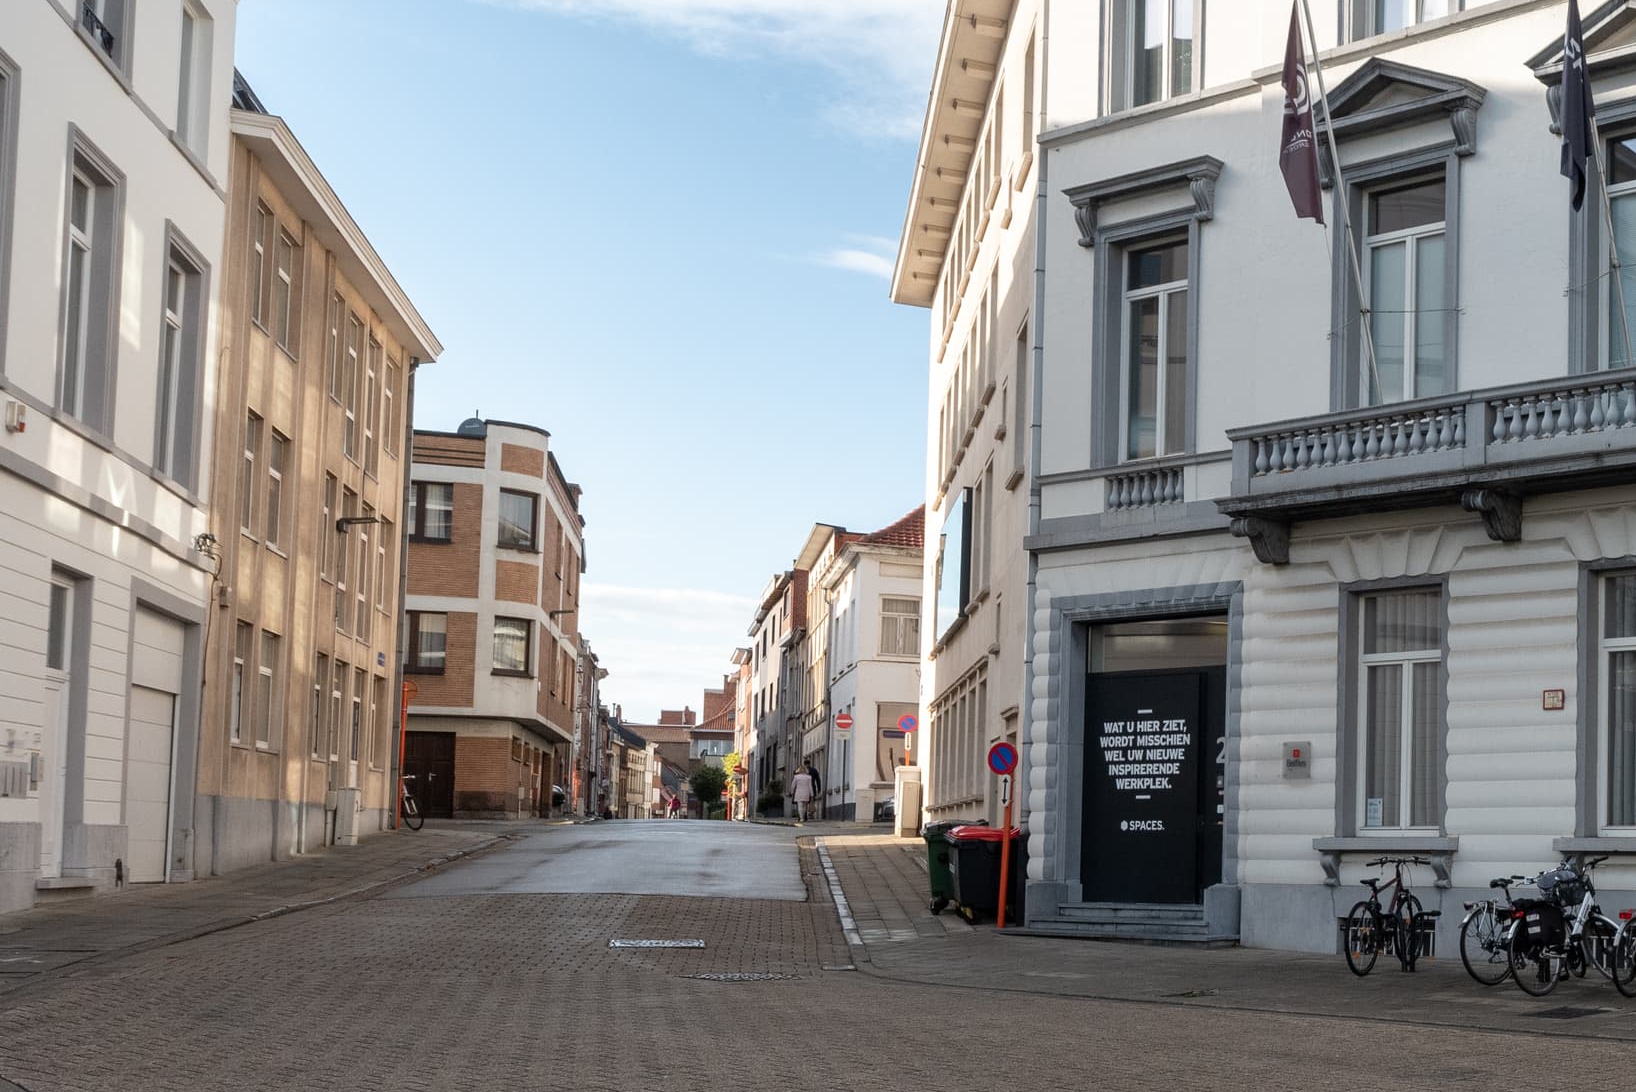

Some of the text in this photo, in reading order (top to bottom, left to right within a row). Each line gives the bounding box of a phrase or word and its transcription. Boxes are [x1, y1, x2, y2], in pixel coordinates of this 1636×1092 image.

[1103, 719, 1187, 733] WAT U HIER ZIET,
[1100, 734, 1190, 748] WORDT MISSCHIEN
[1104, 748, 1185, 762] WEL UW NIEUWE
[1108, 763, 1180, 776] INSPIRERENDE
[1115, 777, 1172, 790] WERKPLEK.
[1129, 820, 1165, 831] SPACES.
